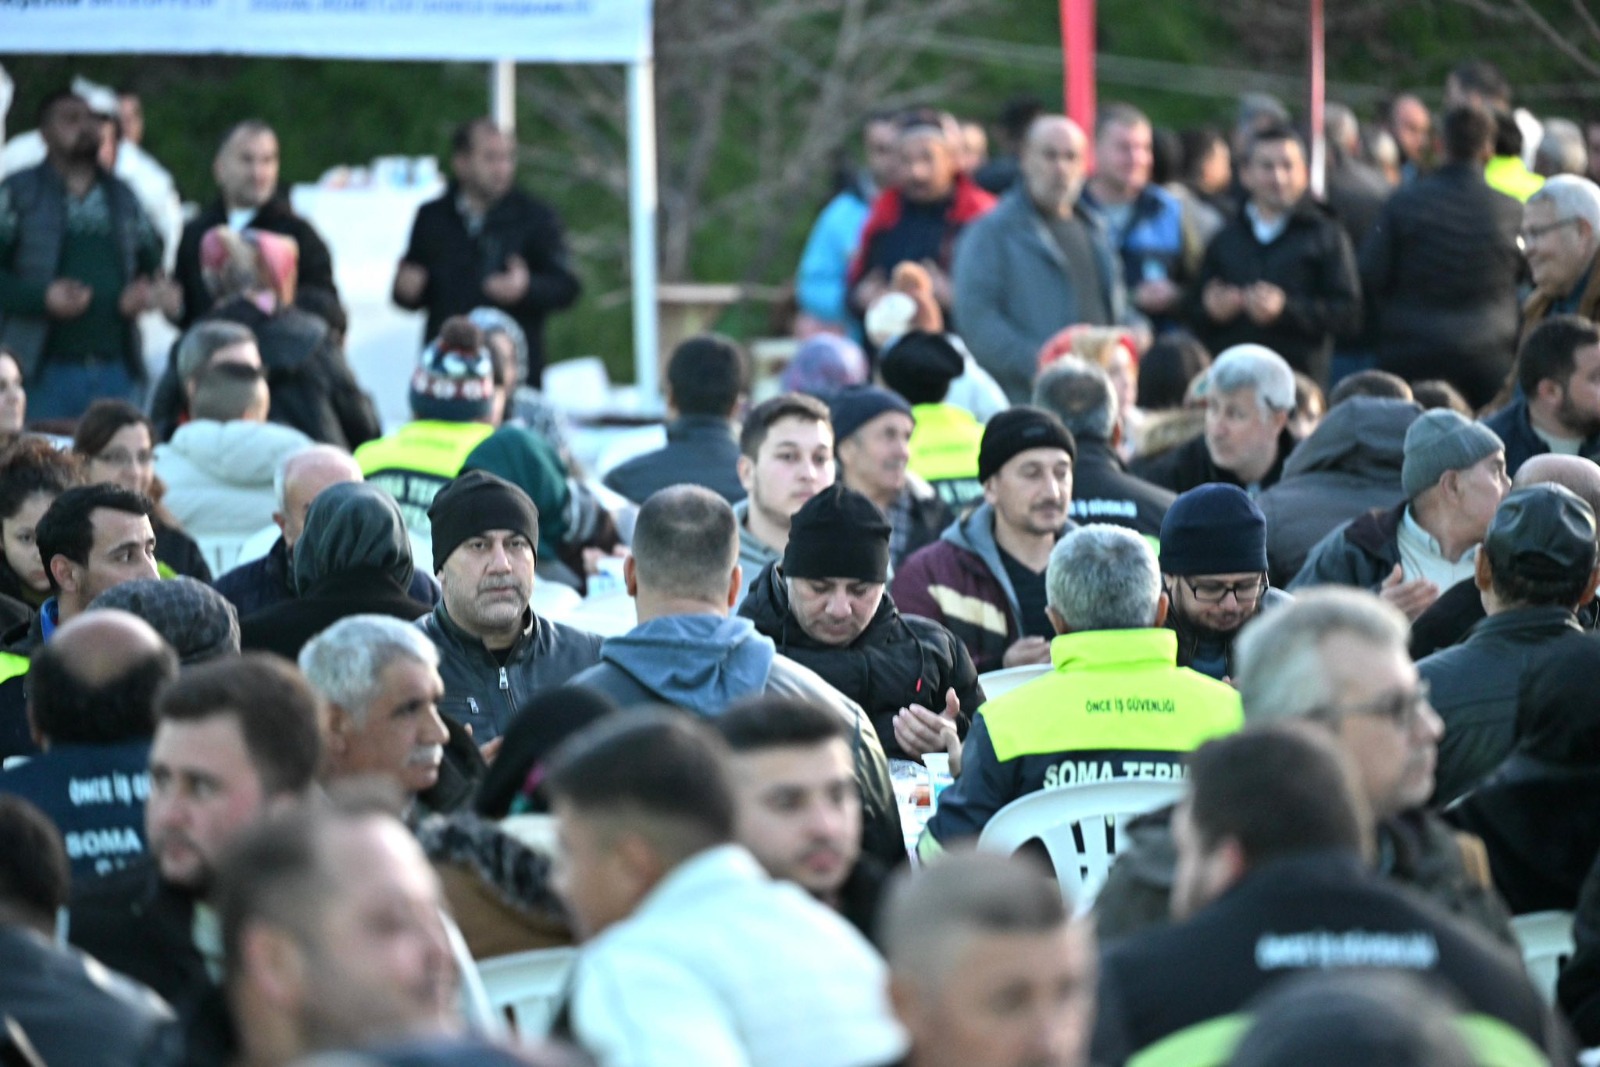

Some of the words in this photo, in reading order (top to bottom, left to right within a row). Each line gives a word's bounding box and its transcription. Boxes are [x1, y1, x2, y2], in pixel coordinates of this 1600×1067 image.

[1085, 697, 1111, 713] ÖNCE
[1114, 696, 1124, 714] İŞ
[1126, 696, 1176, 713] GÜVENLİĞİ
[1043, 759, 1115, 791] SOMA
